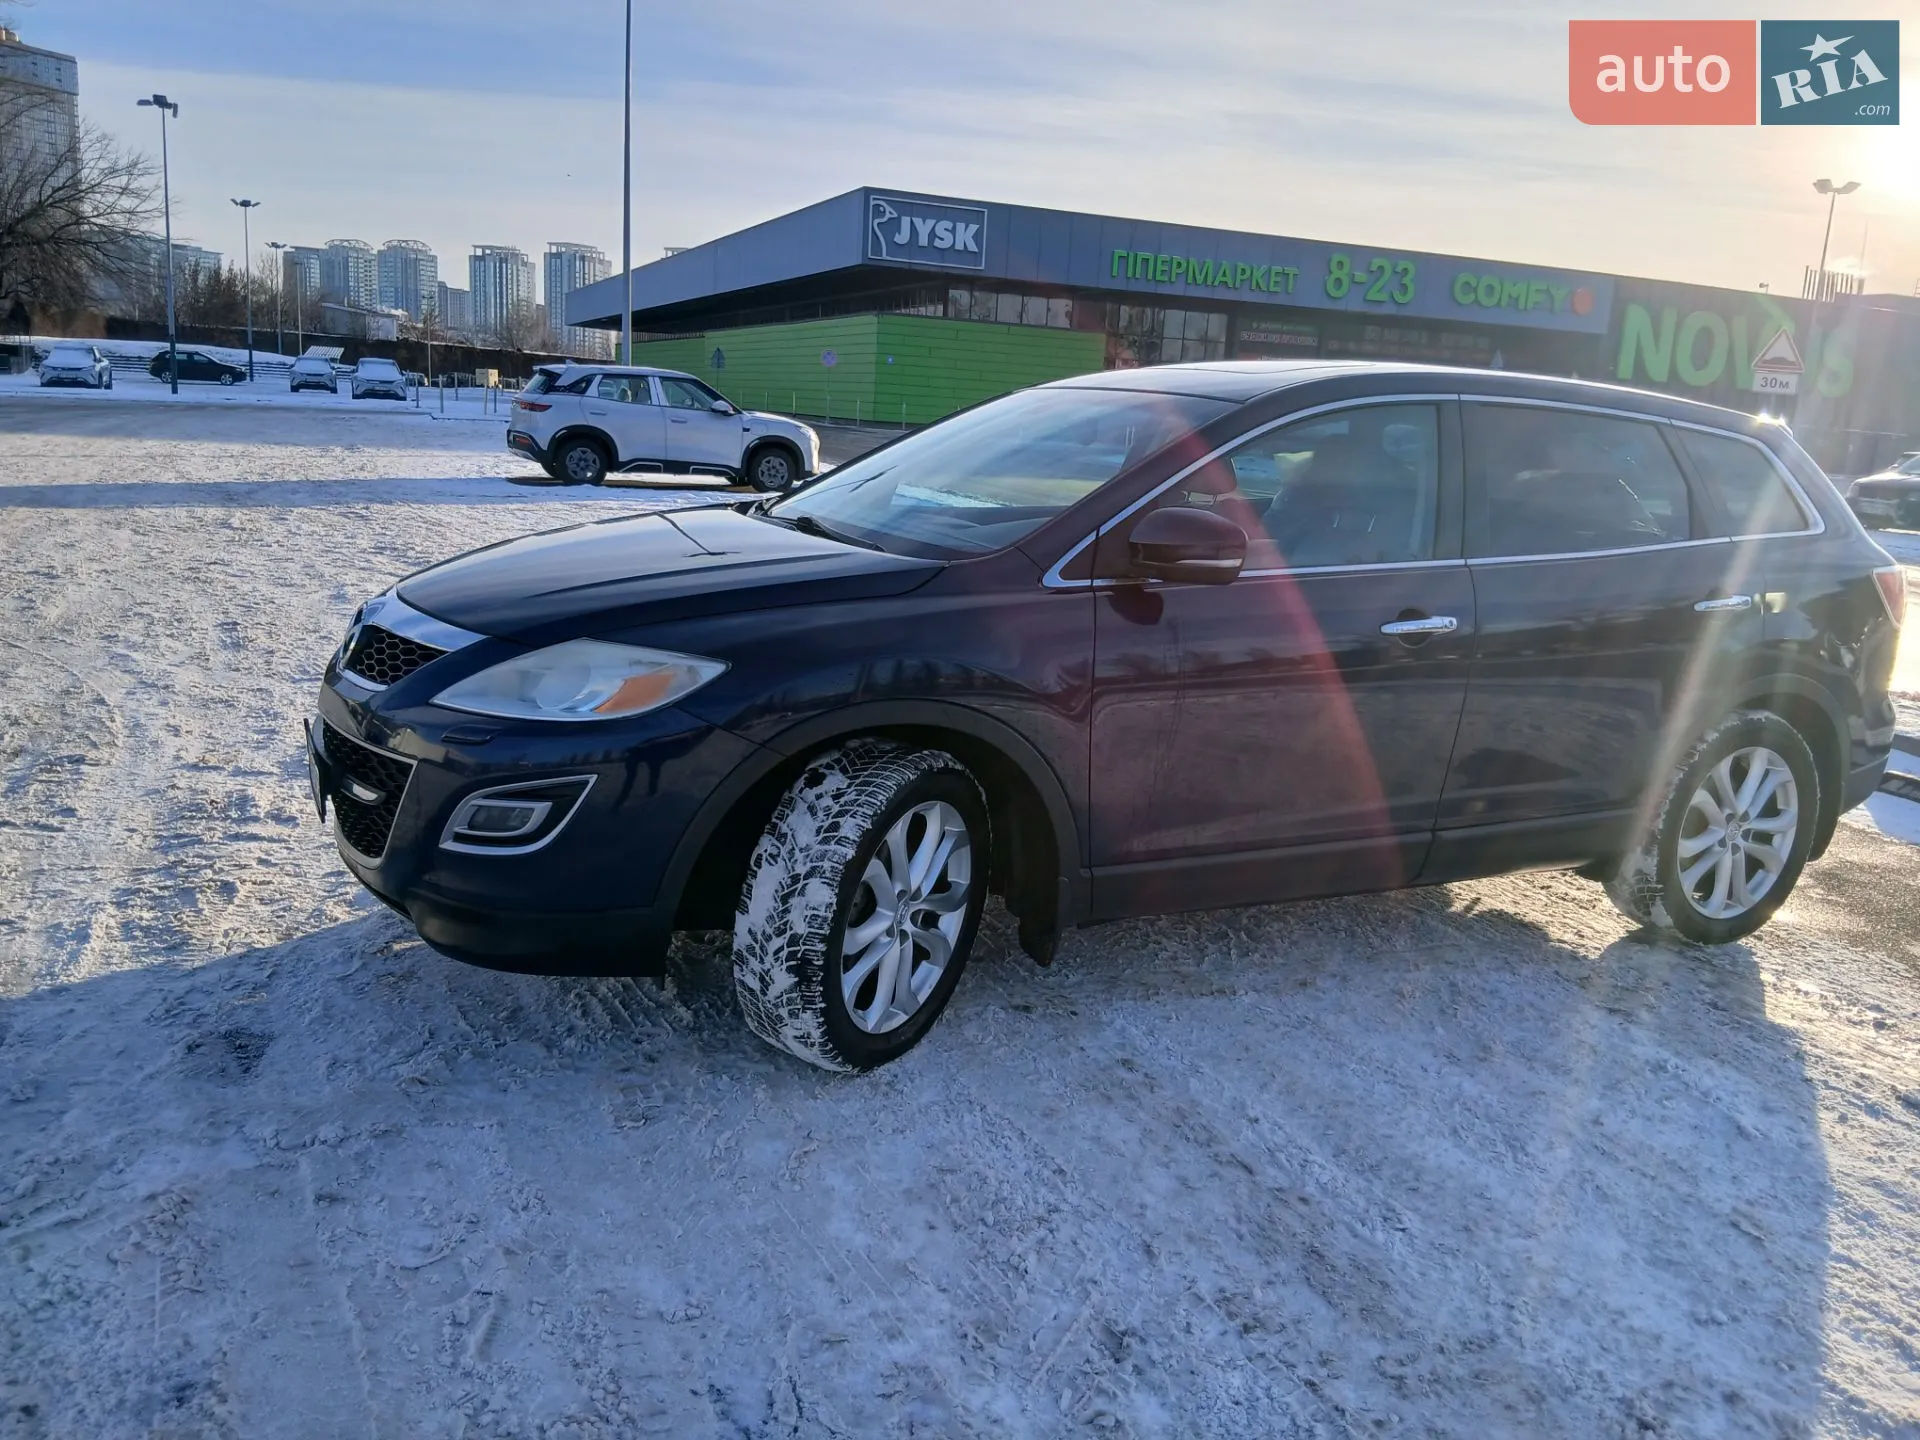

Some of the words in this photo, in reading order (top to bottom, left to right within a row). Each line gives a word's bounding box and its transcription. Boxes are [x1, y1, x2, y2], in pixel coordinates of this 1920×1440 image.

[893, 216, 980, 253] JYSK
[1111, 249, 1300, 295] ГІПЕРМАРКЕТ
[1325, 253, 1417, 304] 8-23
[1453, 271, 1571, 314] COMFY
